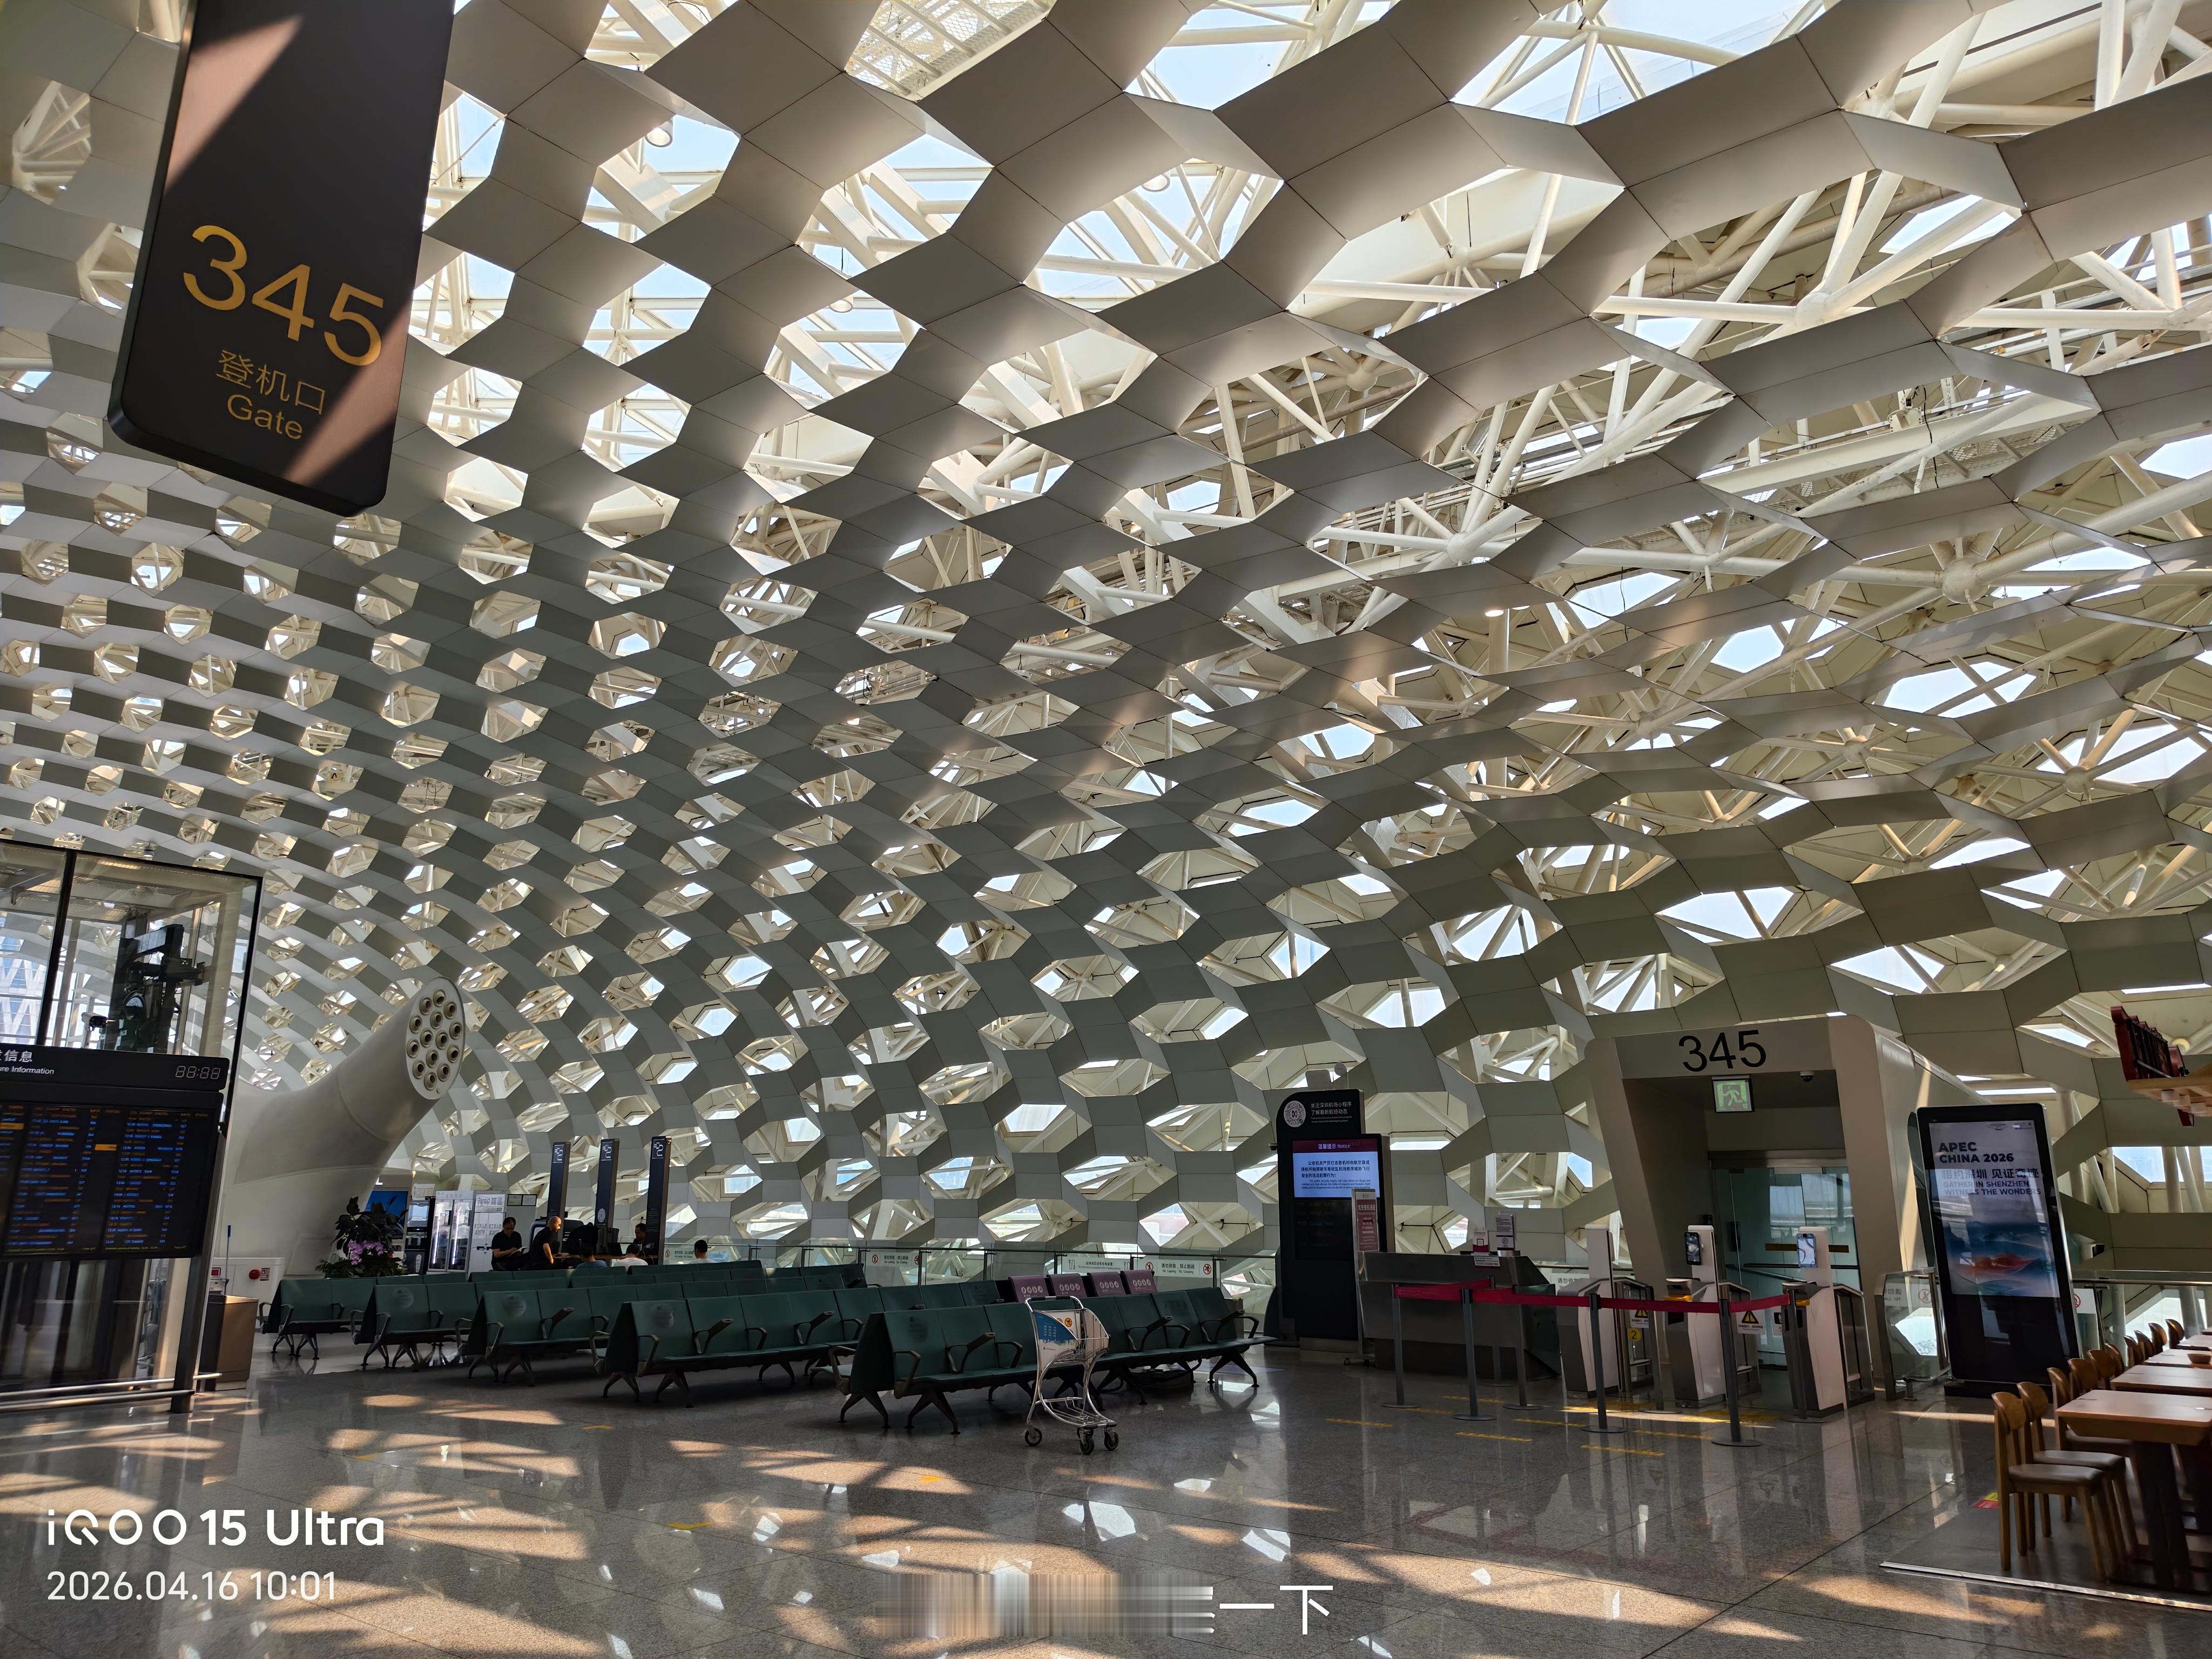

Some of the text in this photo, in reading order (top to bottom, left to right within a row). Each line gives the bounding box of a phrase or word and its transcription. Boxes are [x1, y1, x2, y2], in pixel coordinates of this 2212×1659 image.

[183, 225, 384, 367] 345
[216, 349, 325, 415] 登机口
[227, 394, 302, 440] Gate
[0, 1049, 32, 1062] 信息
[1678, 1029, 1766, 1072] 345
[11, 1066, 54, 1075] Information
[1939, 1142, 1977, 1152] APEC
[1939, 1153, 2014, 1163] CHINA 2026
[1941, 1168, 2039, 1179] 相约深圳 见证奇迹
[1630, 1330, 1637, 1339] 2
